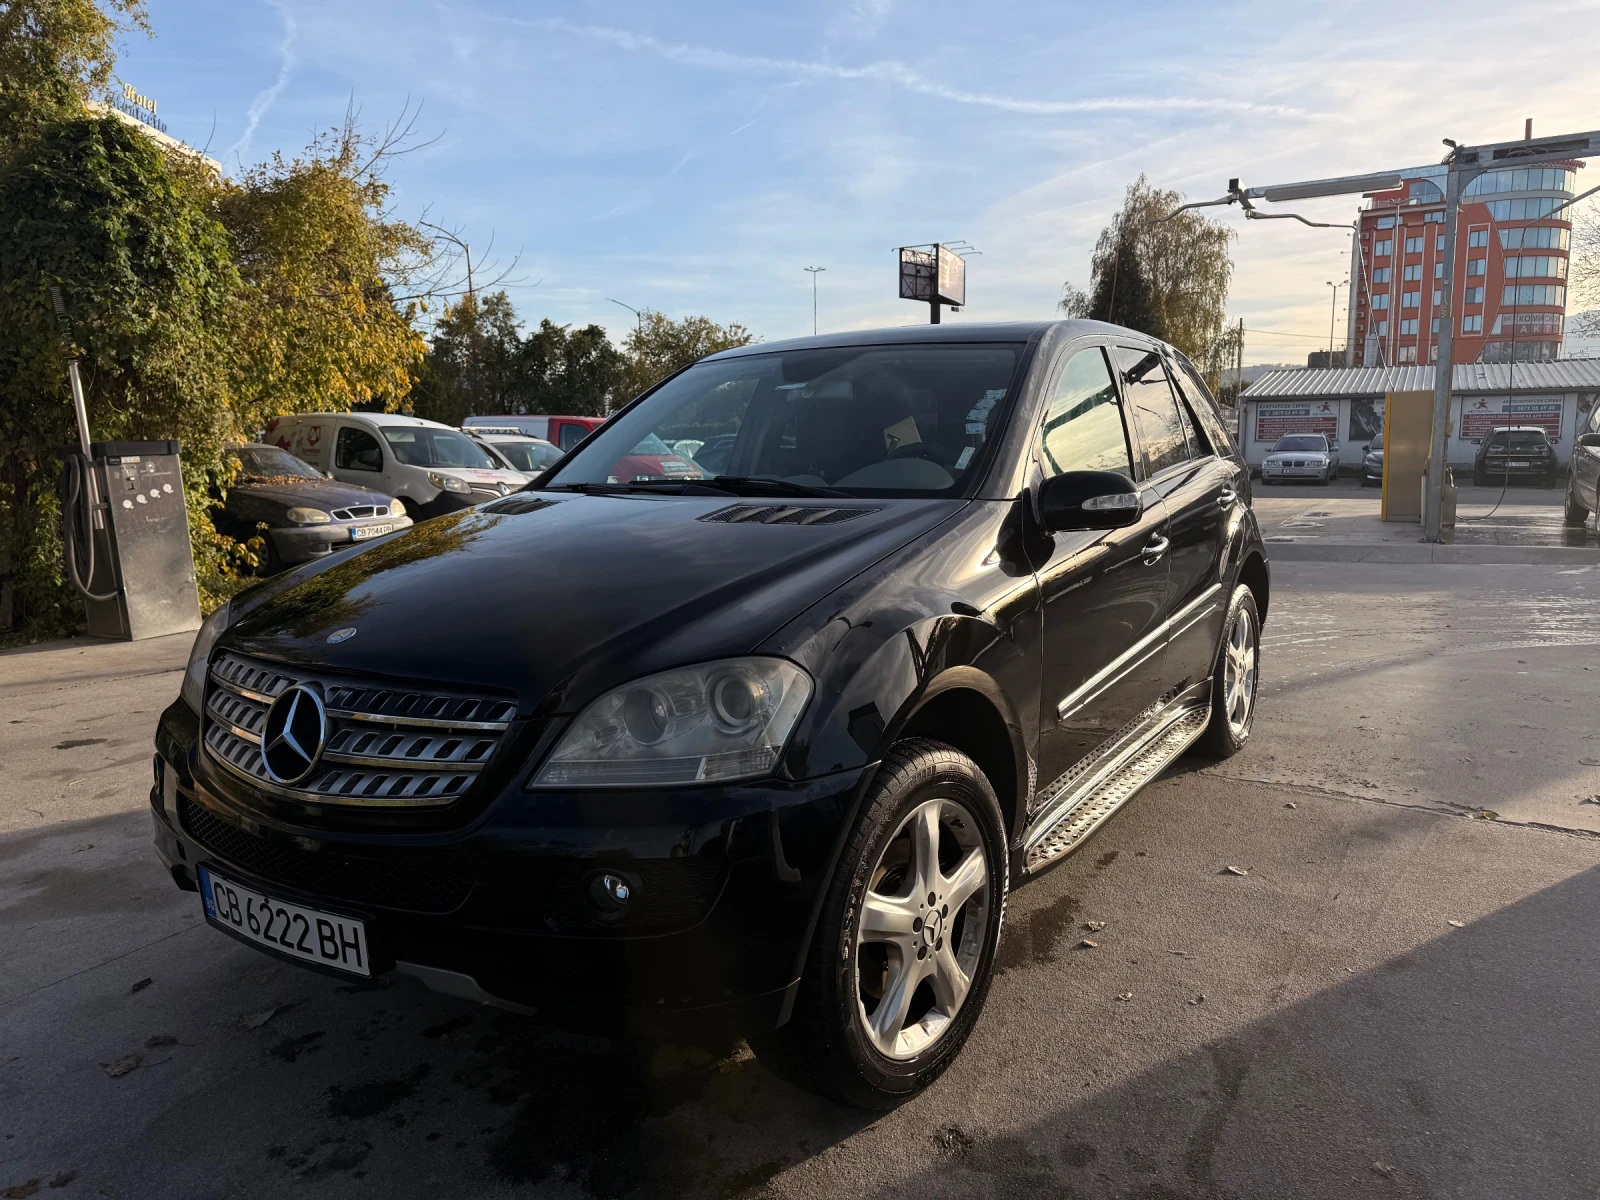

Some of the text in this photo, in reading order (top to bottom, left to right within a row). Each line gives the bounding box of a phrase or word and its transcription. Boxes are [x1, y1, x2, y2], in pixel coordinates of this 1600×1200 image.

[122, 83, 157, 115] Hotel
[367, 527, 383, 536] 7044
[213, 882, 363, 968] CB 6222 BH
